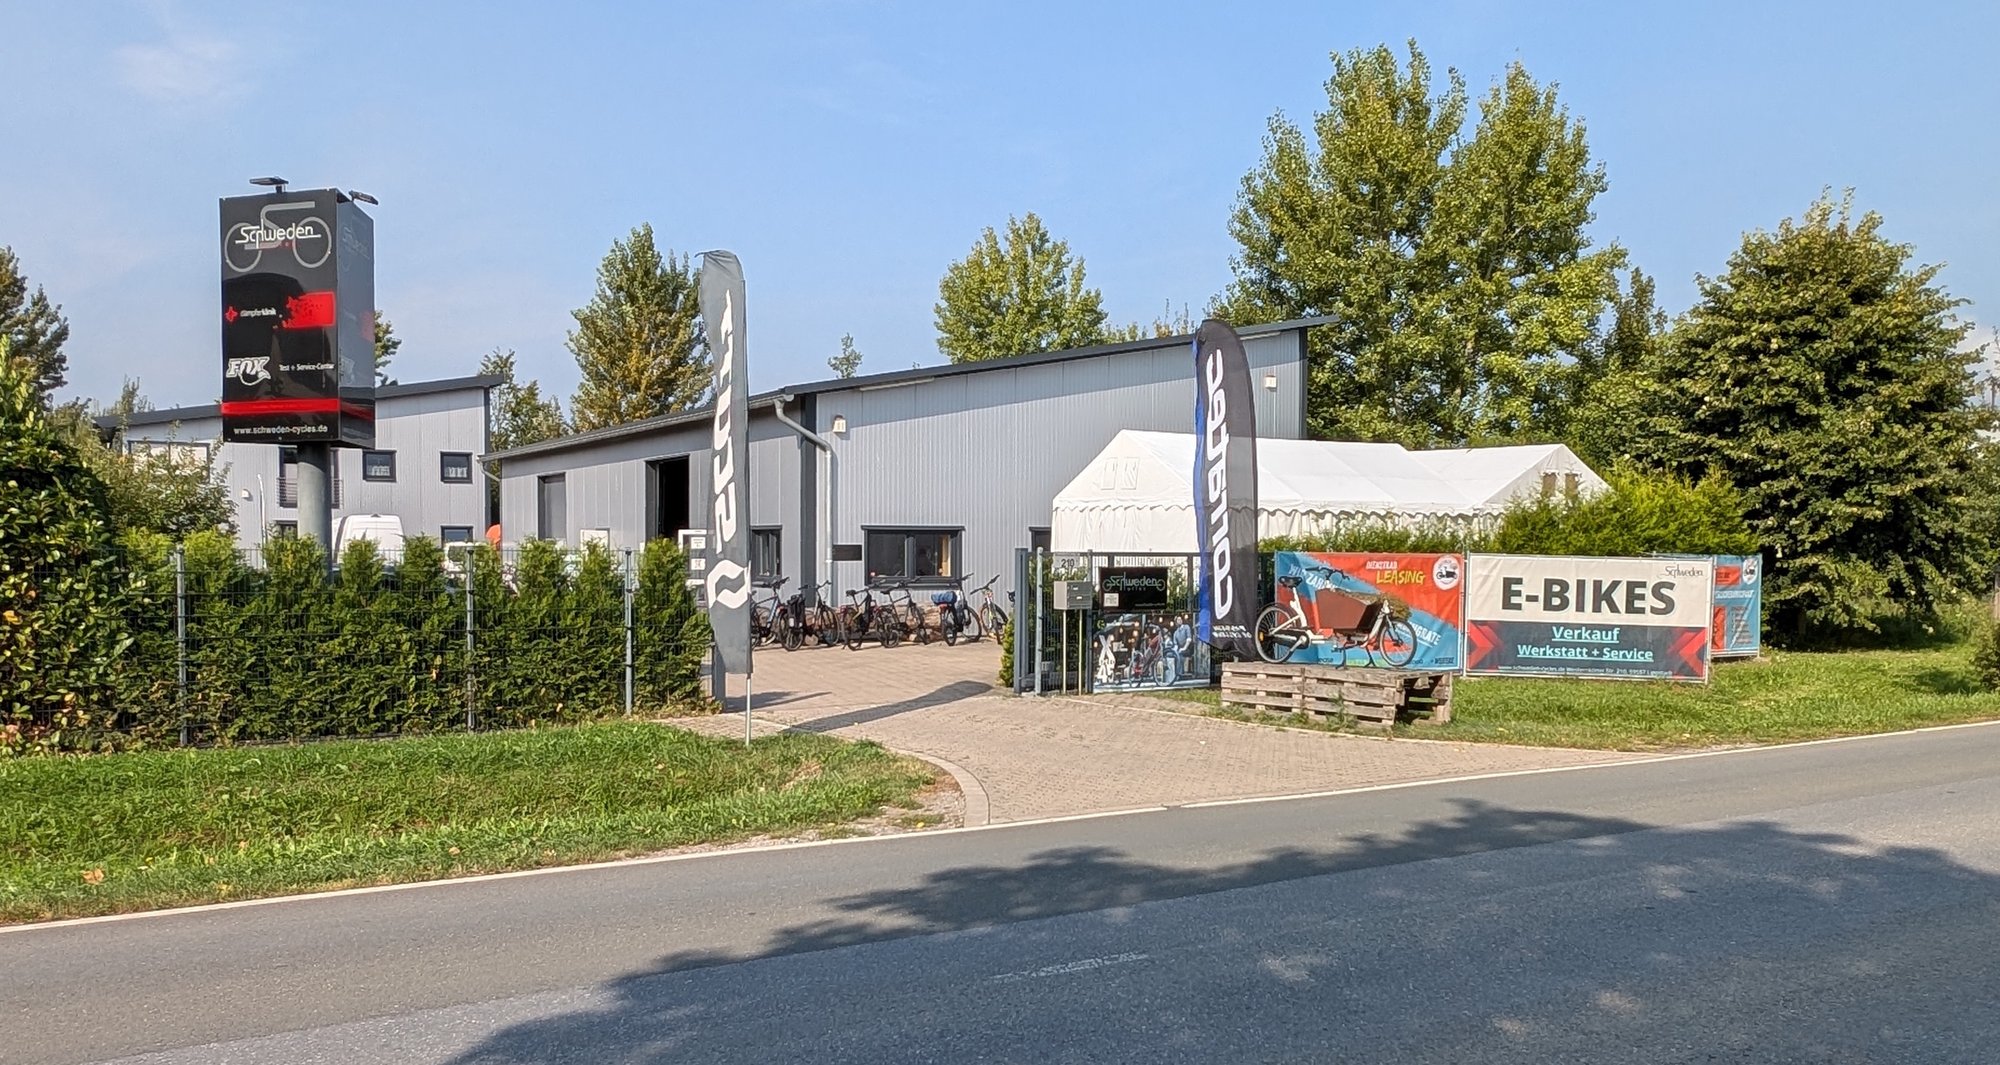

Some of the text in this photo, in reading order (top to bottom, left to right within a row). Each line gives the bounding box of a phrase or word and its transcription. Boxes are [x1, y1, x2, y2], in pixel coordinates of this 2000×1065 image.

[235, 219, 322, 249] Schweden
[226, 356, 271, 386] FOX
[279, 364, 290, 372] Test
[297, 362, 336, 372] Service-Center
[234, 424, 328, 436] www.schweden-cycles.de
[1061, 558, 1075, 569] 210
[1661, 564, 1705, 578] Schweden
[1106, 571, 1162, 591] Schweden
[1376, 569, 1426, 586] LEASING
[1501, 577, 1676, 616] E-BIKES
[1552, 626, 1620, 643] Verkauf
[1517, 644, 1588, 658] Werkstatt
[1602, 647, 1653, 661] Service
